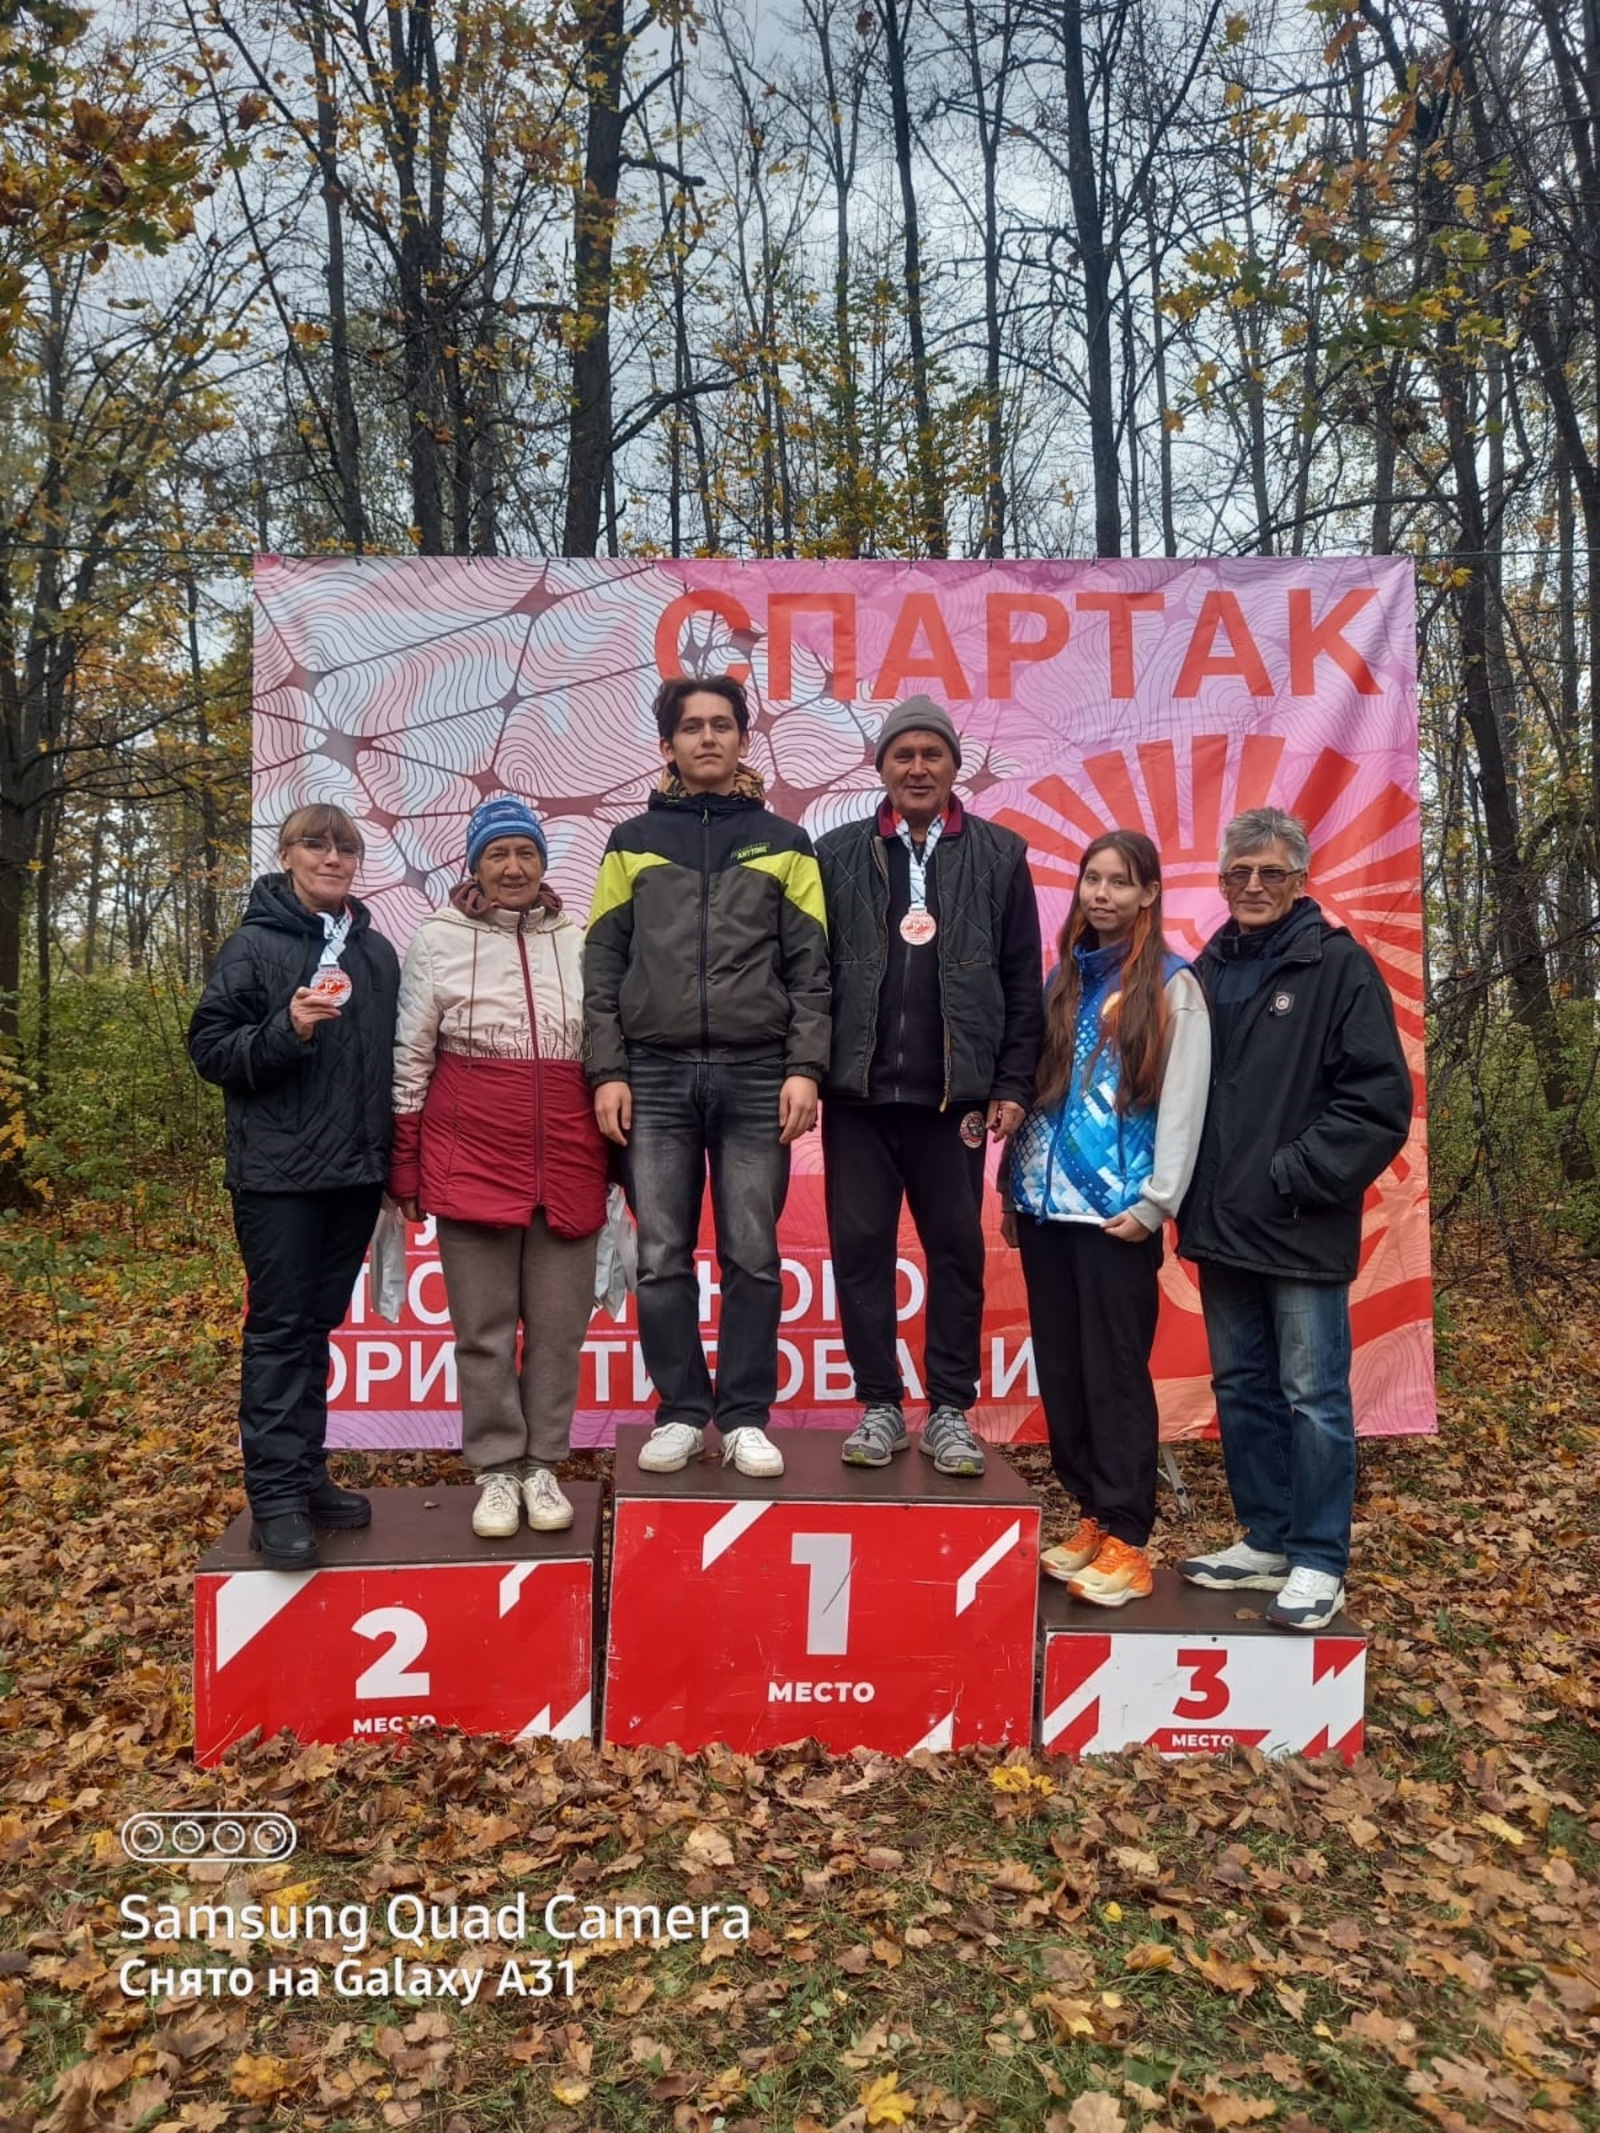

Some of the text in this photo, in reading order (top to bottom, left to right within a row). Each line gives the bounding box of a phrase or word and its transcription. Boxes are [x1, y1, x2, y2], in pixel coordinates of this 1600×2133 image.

[655, 588, 1383, 702] СПАРТАК
[791, 1532, 851, 1655] 1
[352, 1607, 430, 1699] 2
[767, 1680, 875, 1704] МЕСТО
[1173, 1648, 1230, 1719] 3
[1172, 1734, 1234, 1747] МЕСТО
